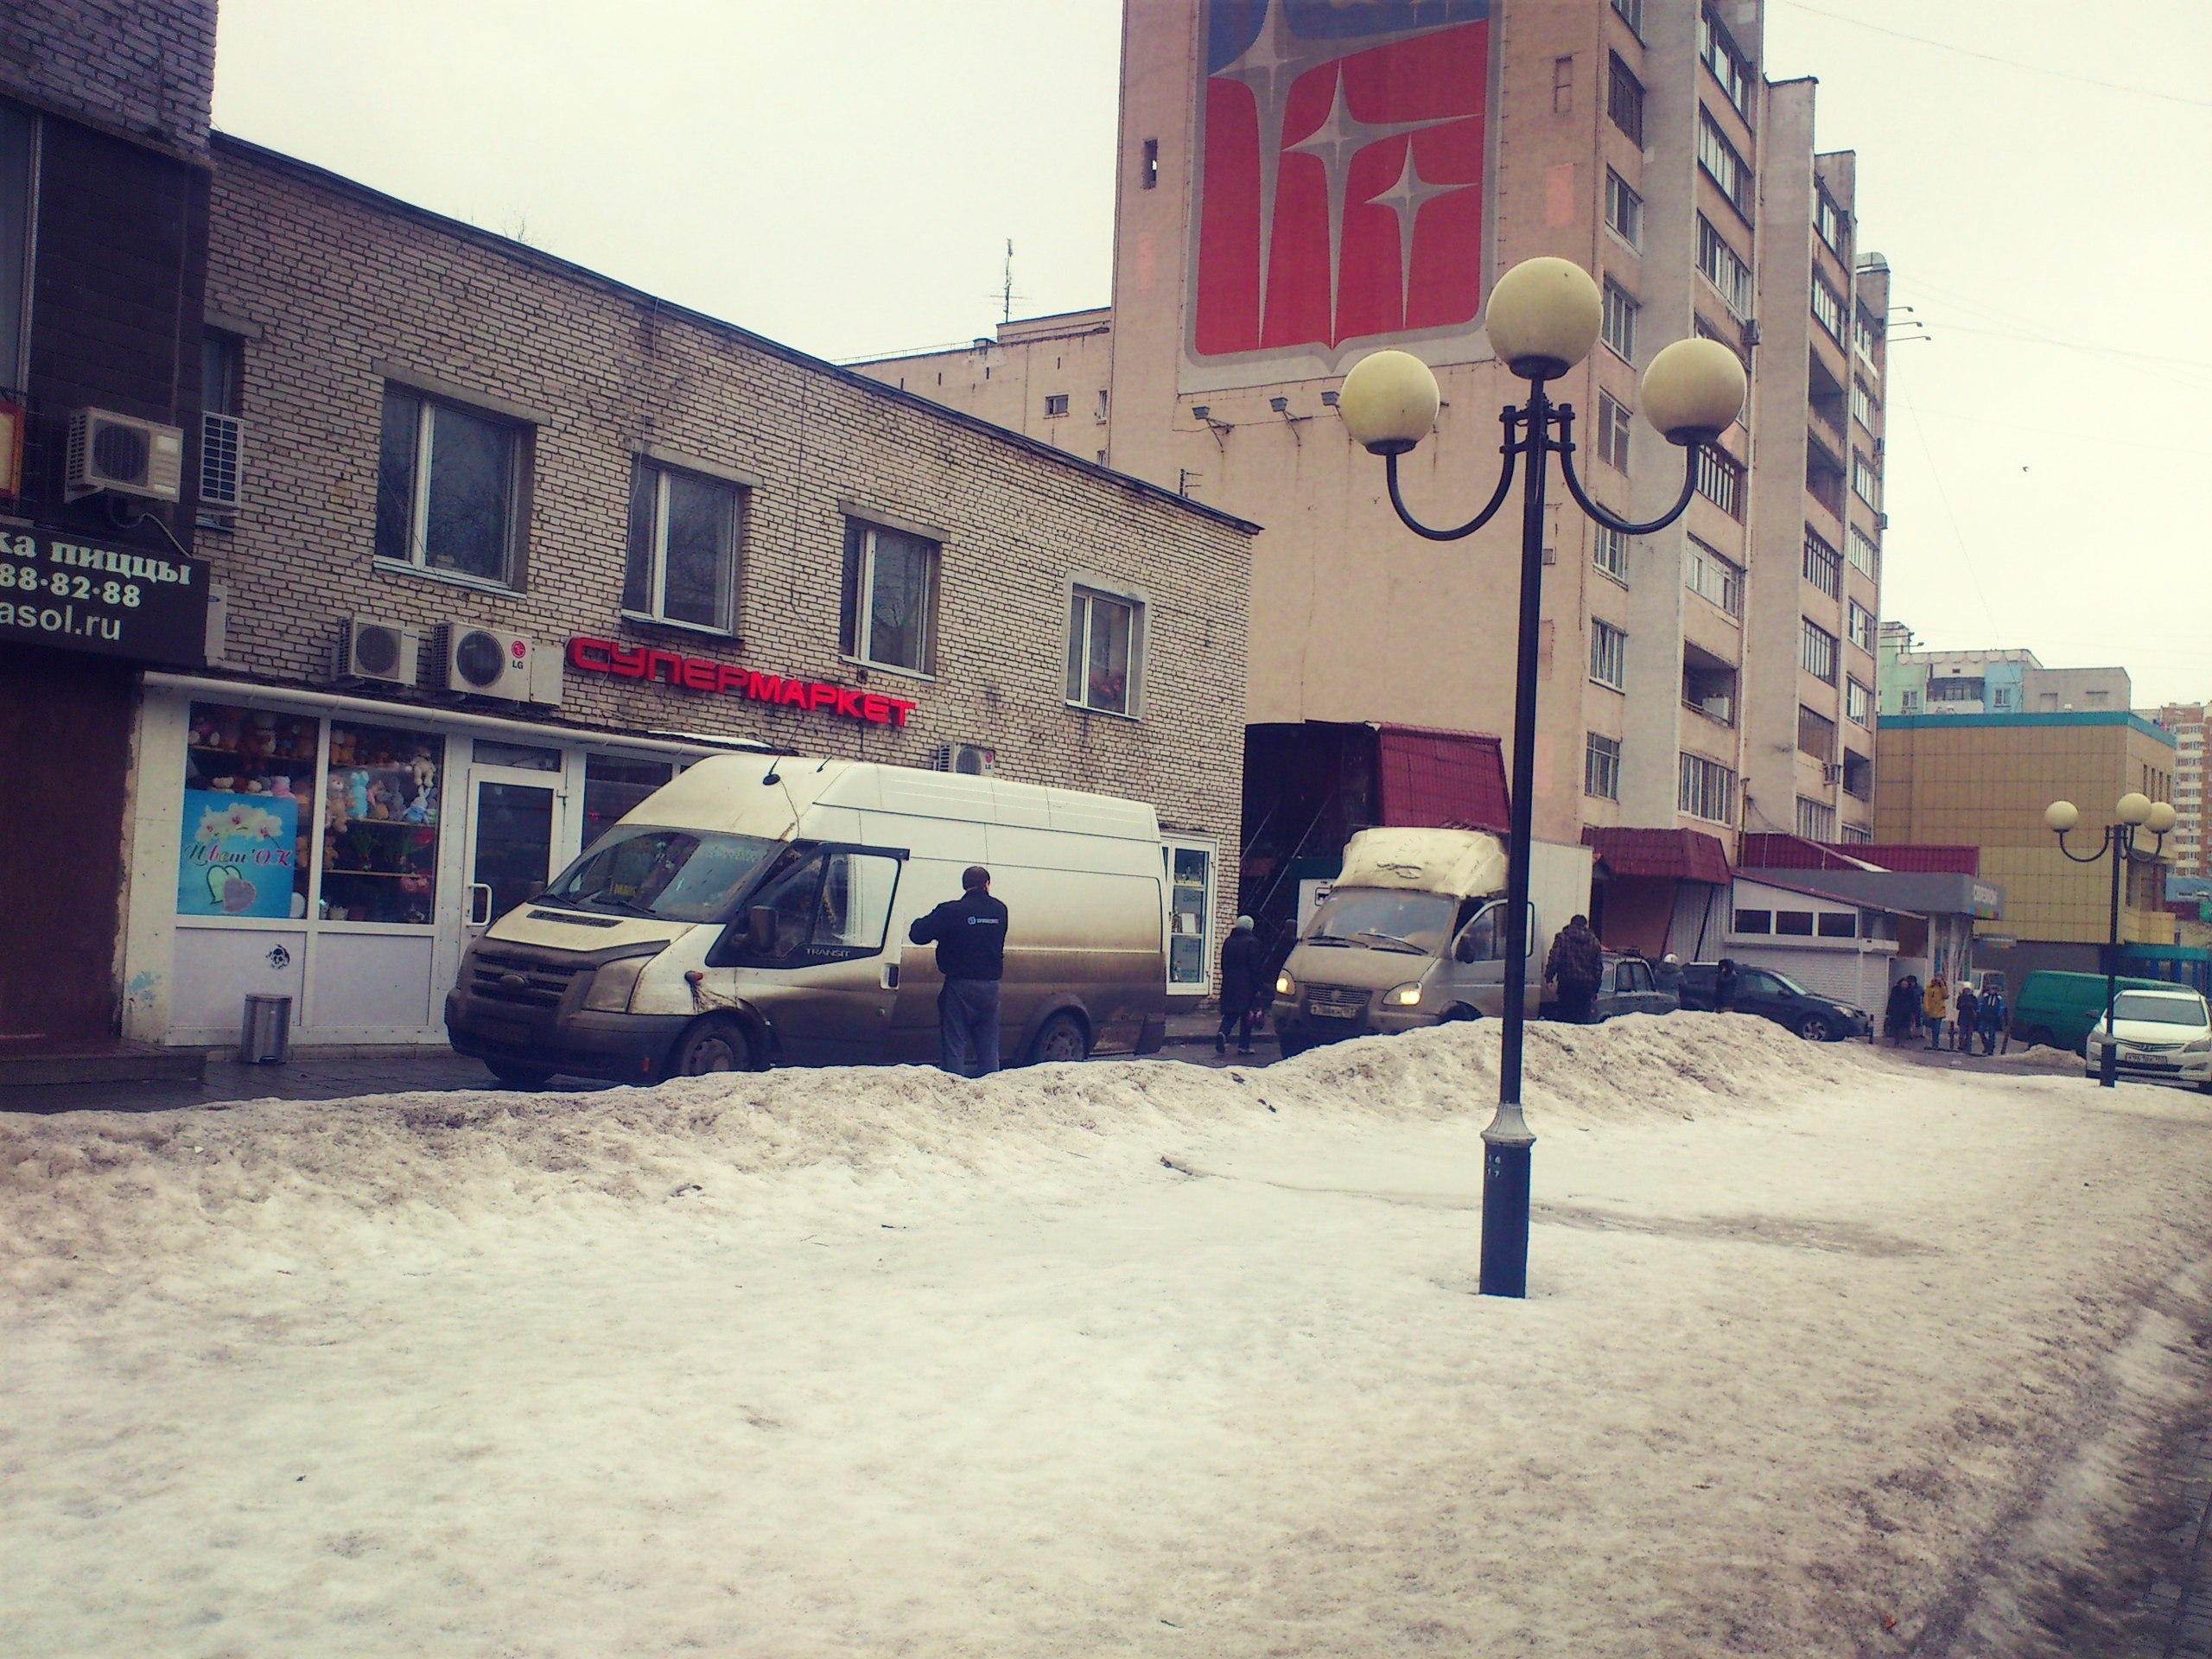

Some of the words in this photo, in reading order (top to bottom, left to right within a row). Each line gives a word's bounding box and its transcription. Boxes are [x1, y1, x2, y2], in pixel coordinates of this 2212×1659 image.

[49, 541, 192, 586] пиццы
[0, 601, 121, 641] asol.ru
[512, 659, 524, 670] LG
[566, 636, 917, 728] СУПЕРМАРКЕТ
[806, 947, 851, 957] TRANSIT
